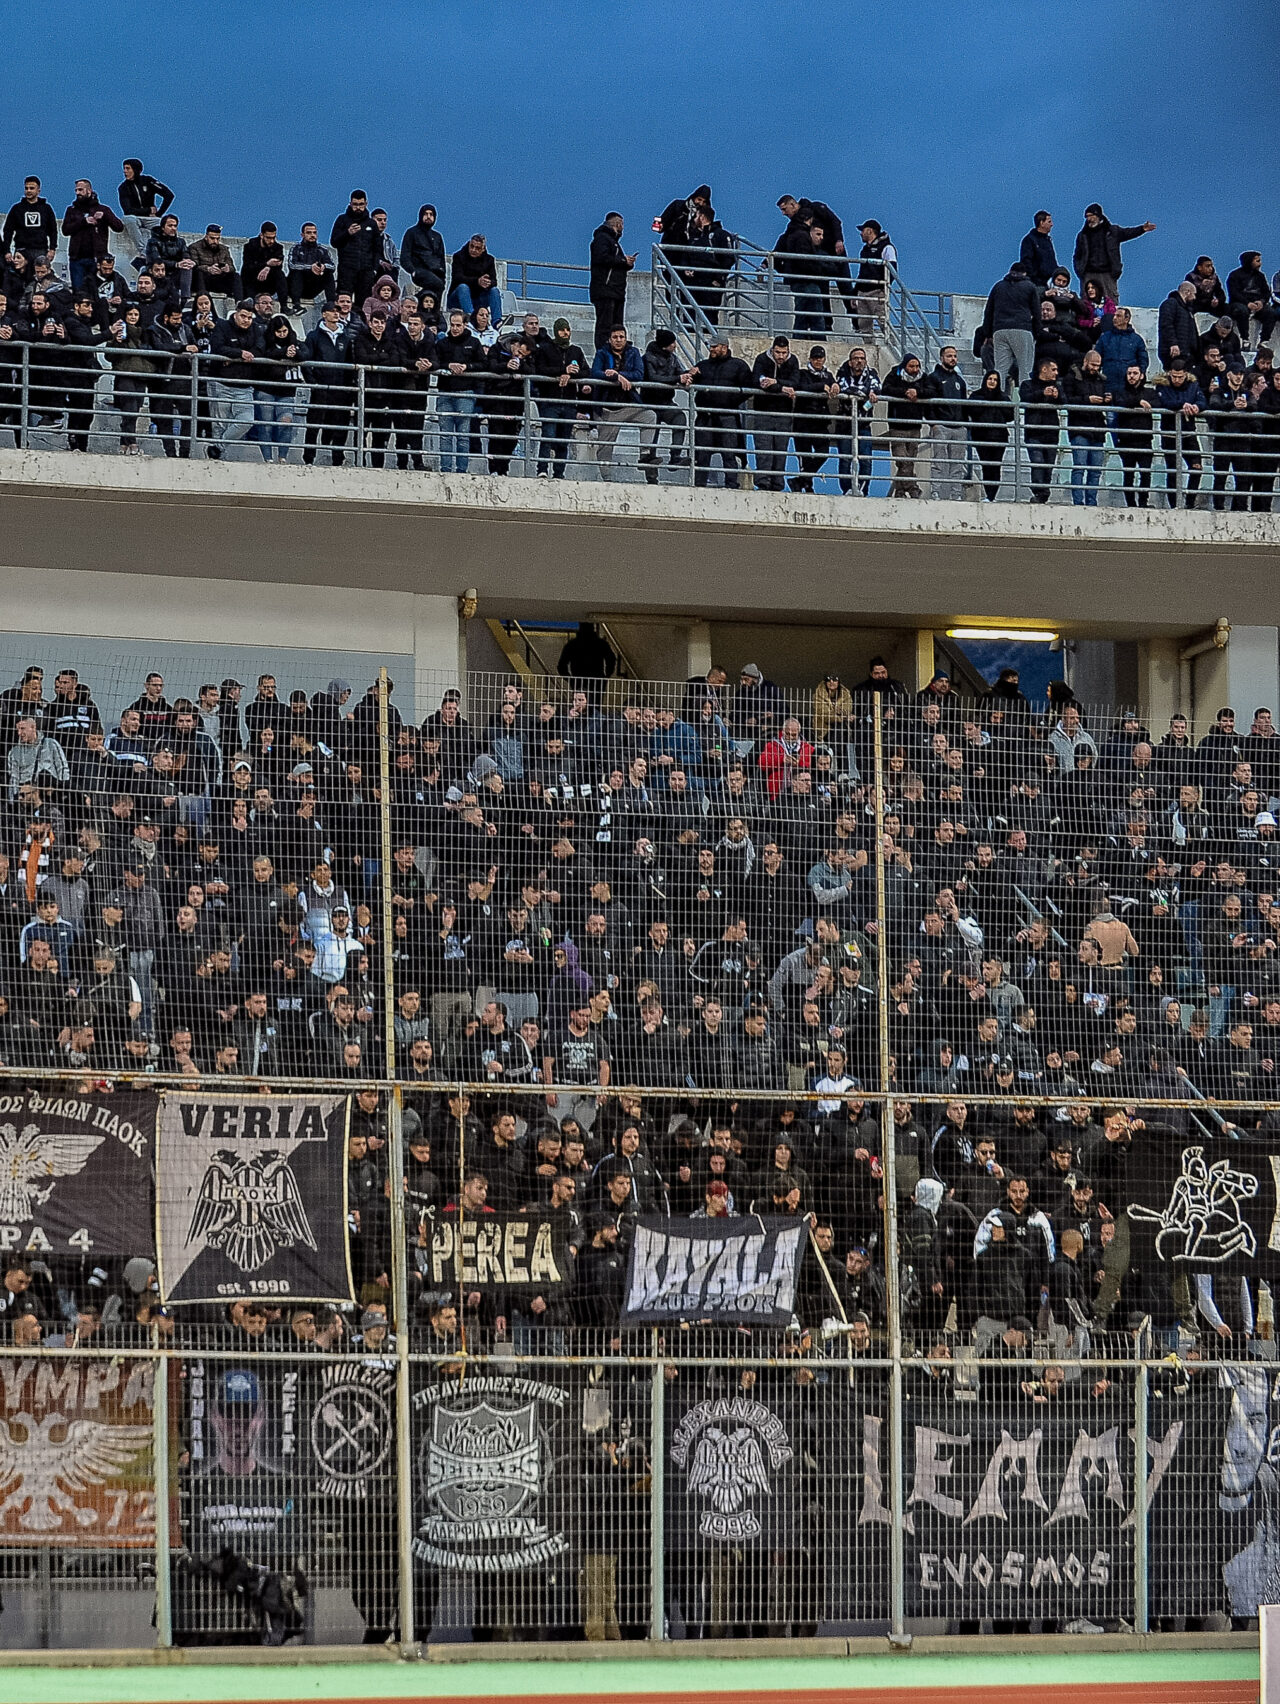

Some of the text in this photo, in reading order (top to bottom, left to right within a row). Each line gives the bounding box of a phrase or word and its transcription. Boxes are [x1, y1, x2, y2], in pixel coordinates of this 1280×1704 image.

[91, 1110, 148, 1158] ΠΑΟΚ
[180, 1104, 328, 1140] VERIA
[222, 1187, 277, 1201] ΠΑΟΚ
[68, 1228, 94, 1251] 4
[432, 1221, 562, 1284] PEREA
[217, 1280, 290, 1295] est. 1990
[670, 1397, 794, 1470] ALEXANDRIA
[429, 1448, 540, 1485] SERRES
[858, 1414, 1183, 1536] LEMMY
[919, 1550, 1111, 1590] EVOSMOS
